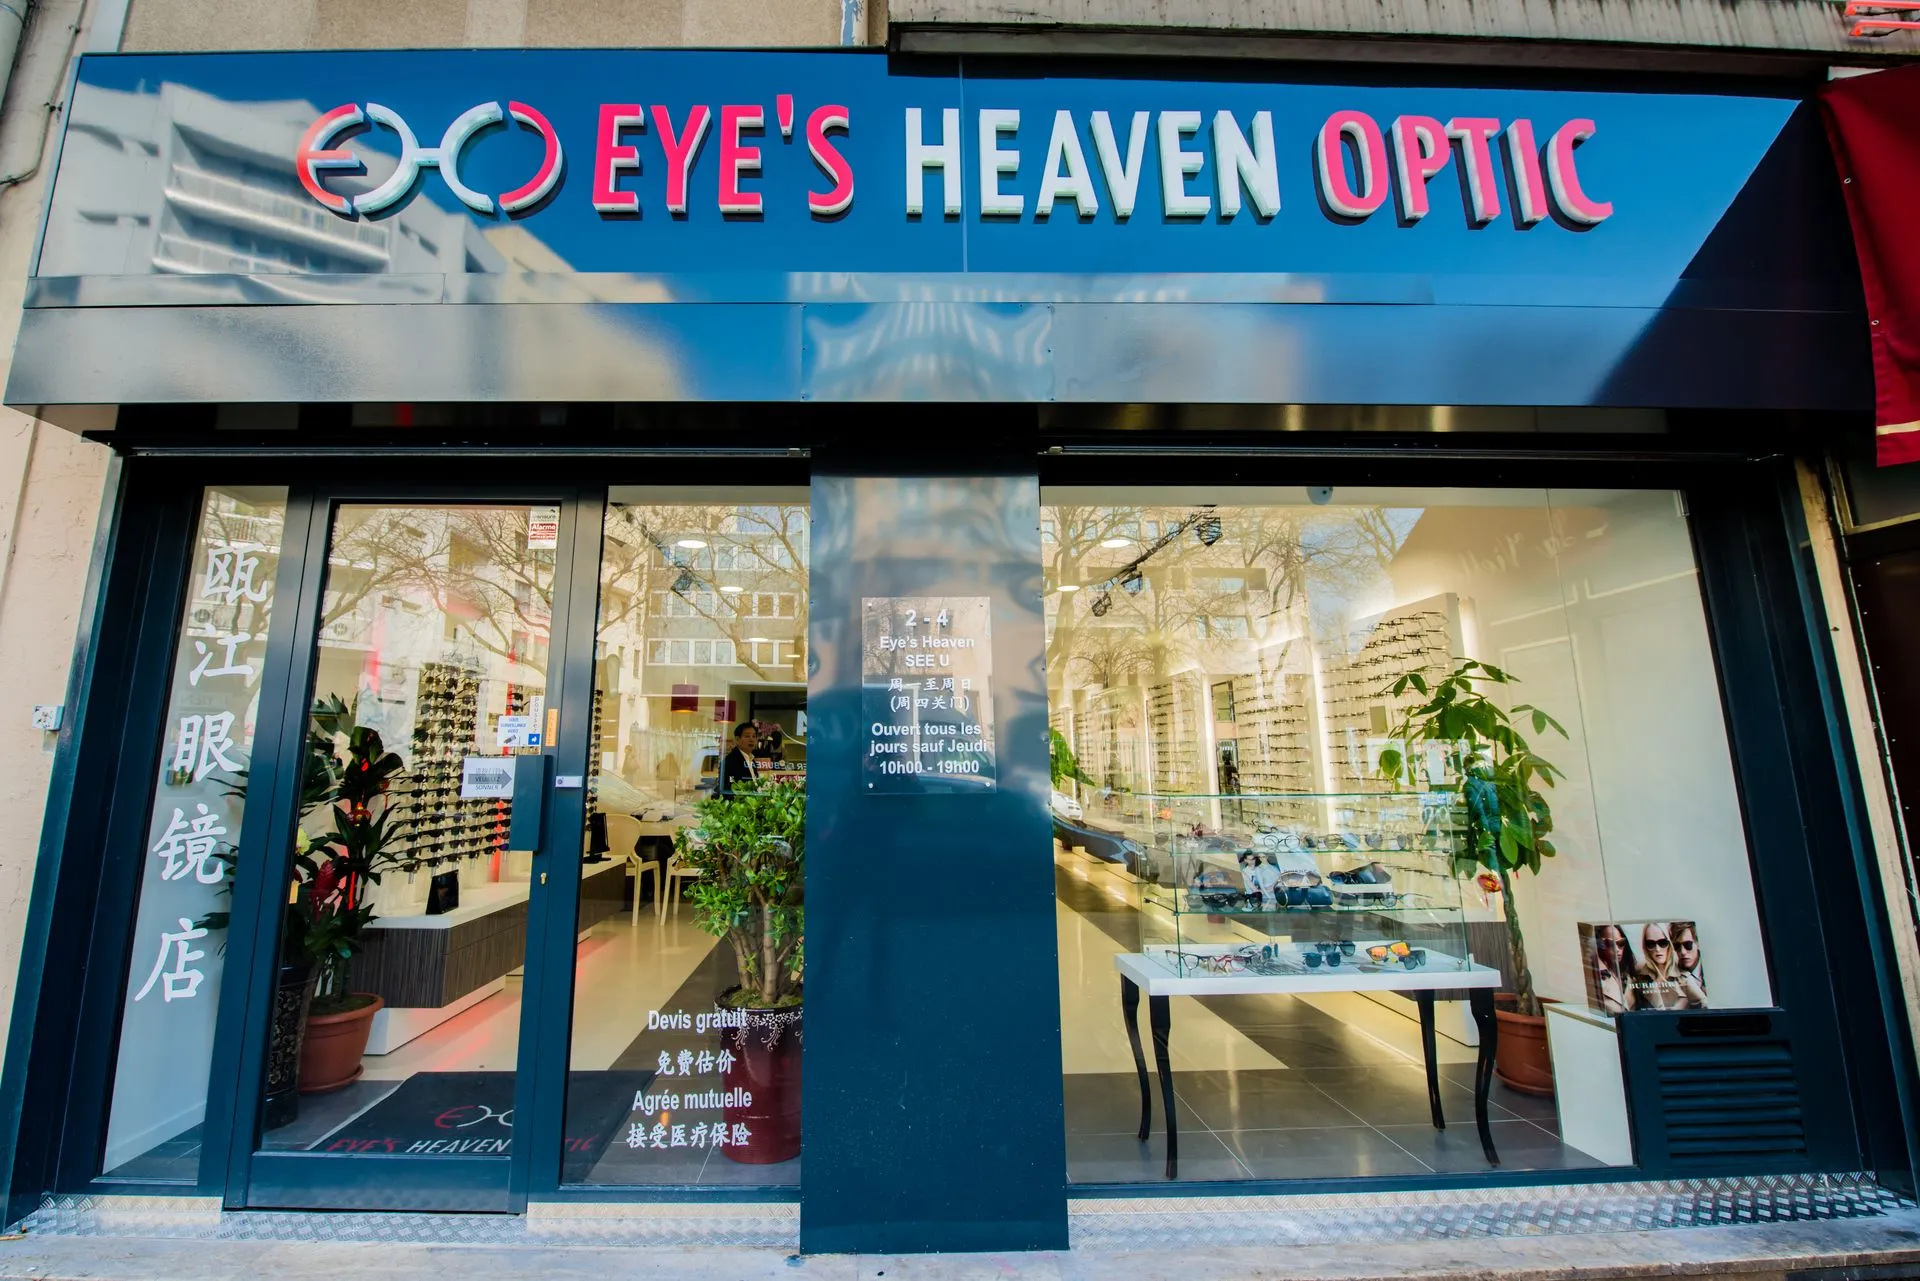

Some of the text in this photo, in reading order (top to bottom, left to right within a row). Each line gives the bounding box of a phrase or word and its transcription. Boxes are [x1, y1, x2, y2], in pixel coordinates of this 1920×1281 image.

[593, 94, 1614, 225] EYE'S HEAVEN OPTIC
[905, 609, 917, 627] 2
[936, 608, 949, 627] 4
[879, 635, 975, 650] Eye's Heaven
[905, 654, 950, 668] SEE U
[888, 678, 972, 692] 周一至周日
[871, 722, 982, 736] Ouvert tous les
[869, 740, 987, 757] jours sauf Jeudi
[135, 543, 268, 1003] 瓯江眼镜店
[879, 760, 923, 774] 10h00
[936, 760, 980, 774] 19h00
[648, 1008, 748, 1034] Devis gratuit
[654, 1049, 737, 1076] 免费估价
[632, 1087, 752, 1116] Agrée mutuelle
[626, 1122, 753, 1149] 接受医疗保险
[405, 1138, 512, 1153] HEAVEN
